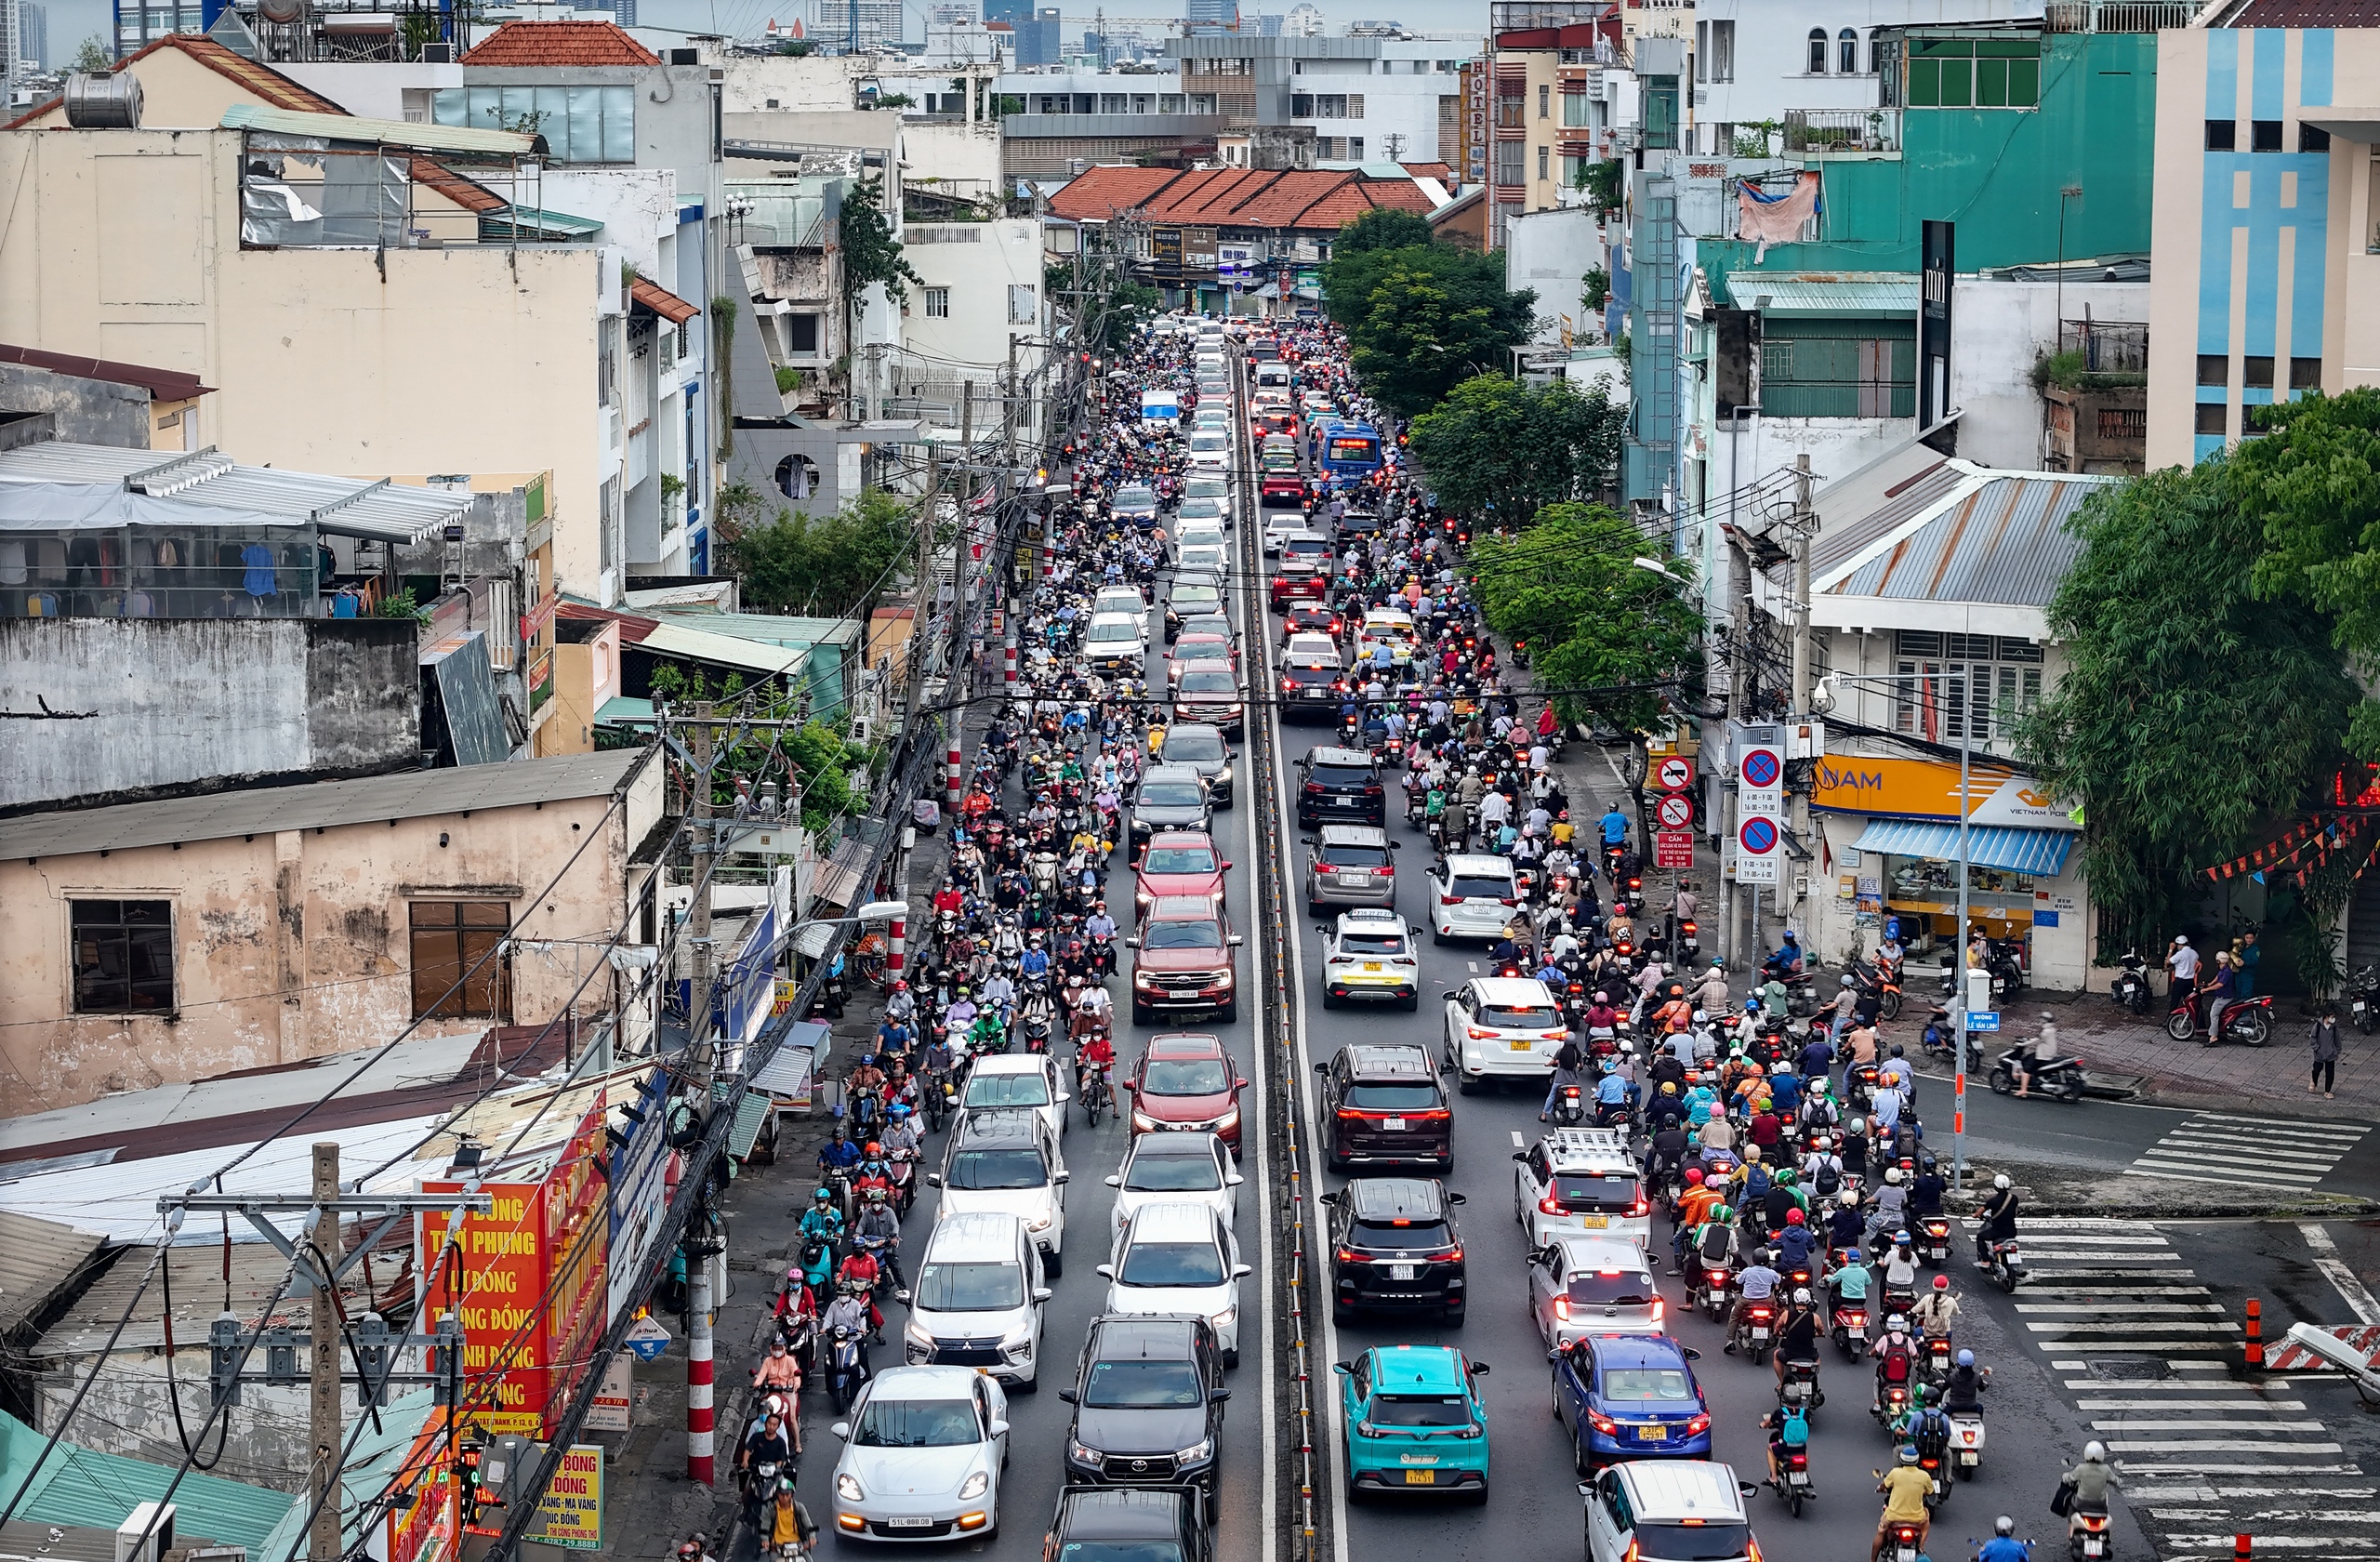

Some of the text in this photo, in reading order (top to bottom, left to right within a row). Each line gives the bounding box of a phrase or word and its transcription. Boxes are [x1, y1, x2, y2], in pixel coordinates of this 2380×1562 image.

[1473, 61, 1484, 142] HOTEL
[2009, 808, 2046, 816] VIETNAM
[1668, 833, 1683, 842] CẤM
[472, 1230, 536, 1258] PHỤNG
[471, 1264, 517, 1293] ĐỒNG
[490, 1302, 536, 1330] ĐỒNG
[554, 1471, 587, 1494] ĐỒNG
[578, 1496, 597, 1511] VÀNG
